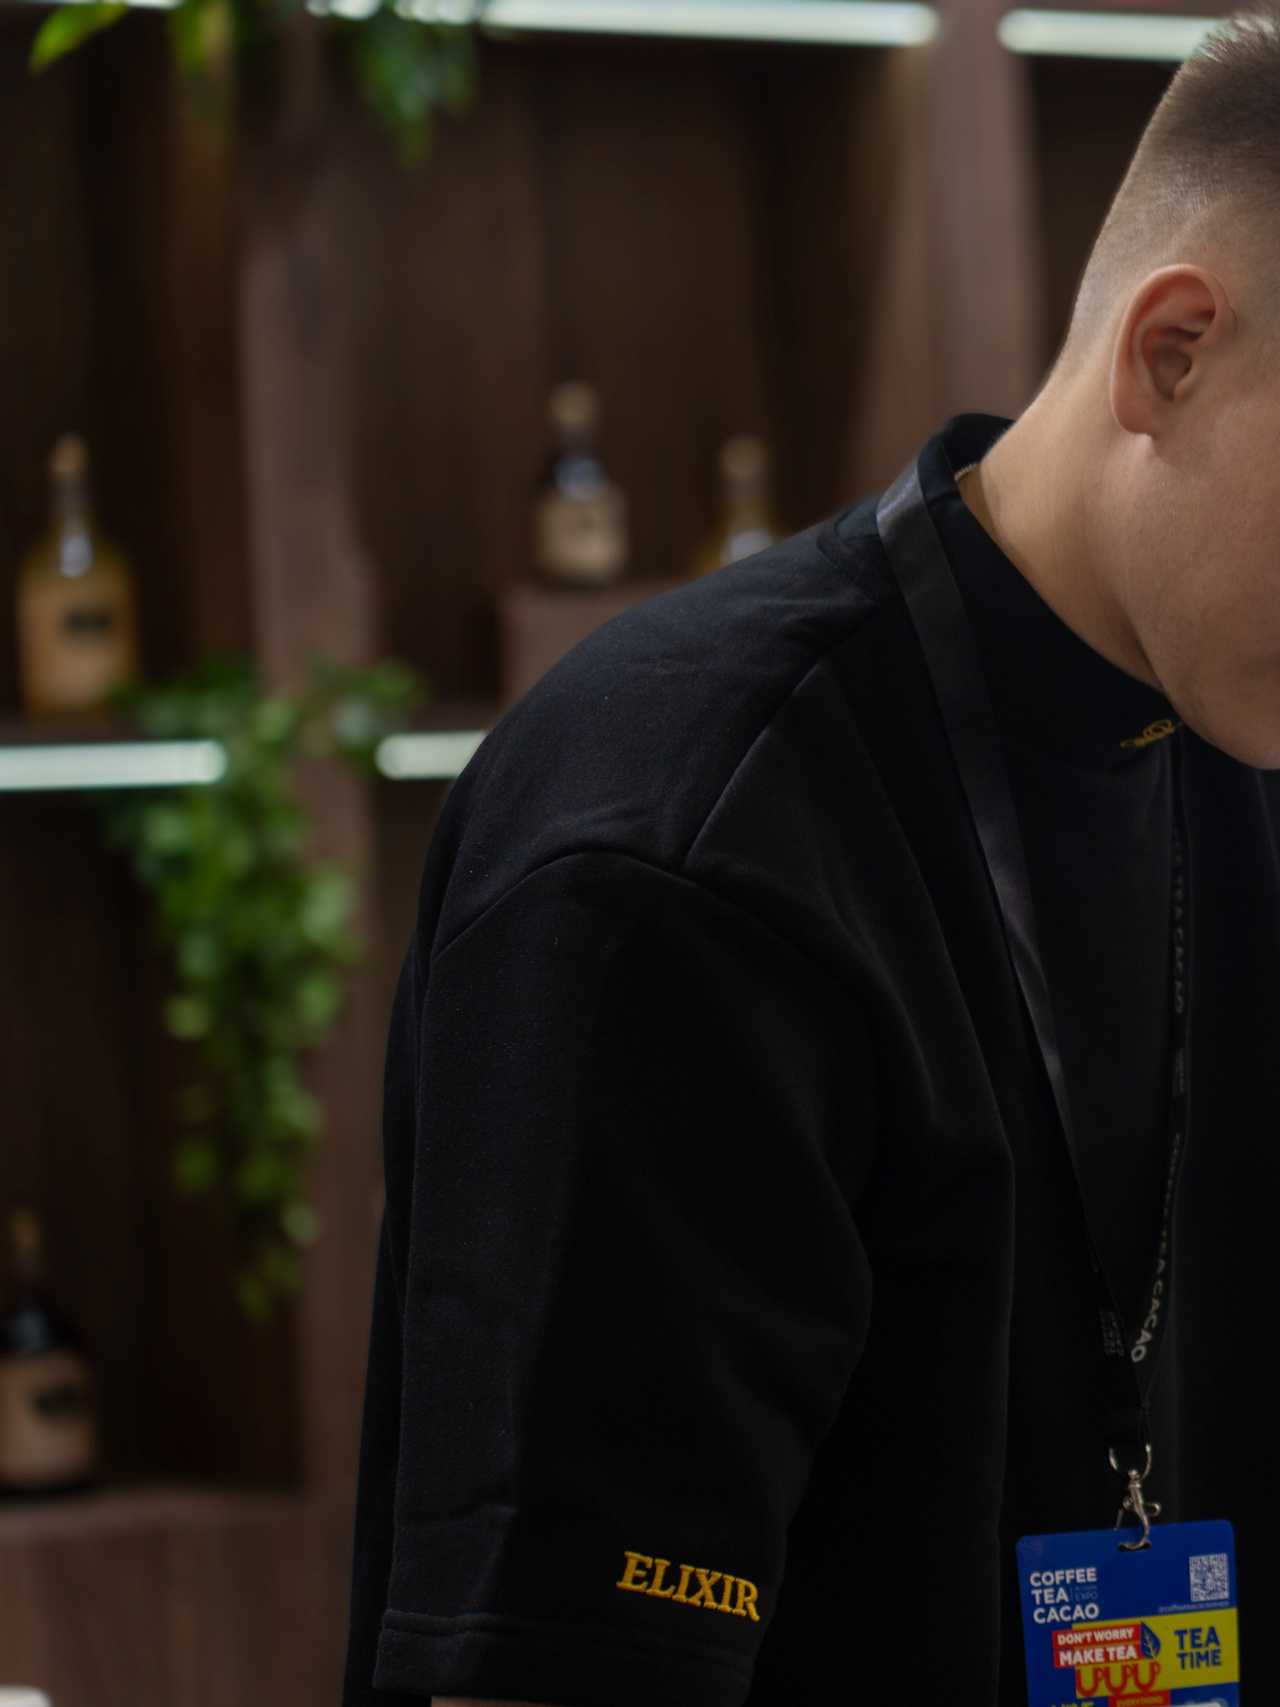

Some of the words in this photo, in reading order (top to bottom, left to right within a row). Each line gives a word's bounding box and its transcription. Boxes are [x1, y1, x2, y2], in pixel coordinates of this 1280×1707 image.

[1130, 1279, 1164, 1363] CACAO
[616, 1551, 760, 1622] ELIXIR
[1029, 1566, 1098, 1587] COFFEE
[1031, 1586, 1070, 1605] TEA
[1033, 1602, 1100, 1624] CACAO
[1057, 1632, 1093, 1645] DON'T
[1093, 1627, 1135, 1643] WORRY
[1174, 1626, 1221, 1651] TEA
[1060, 1647, 1105, 1666] MAKE
[1106, 1644, 1138, 1661] TEA
[1177, 1649, 1222, 1671] TIME
